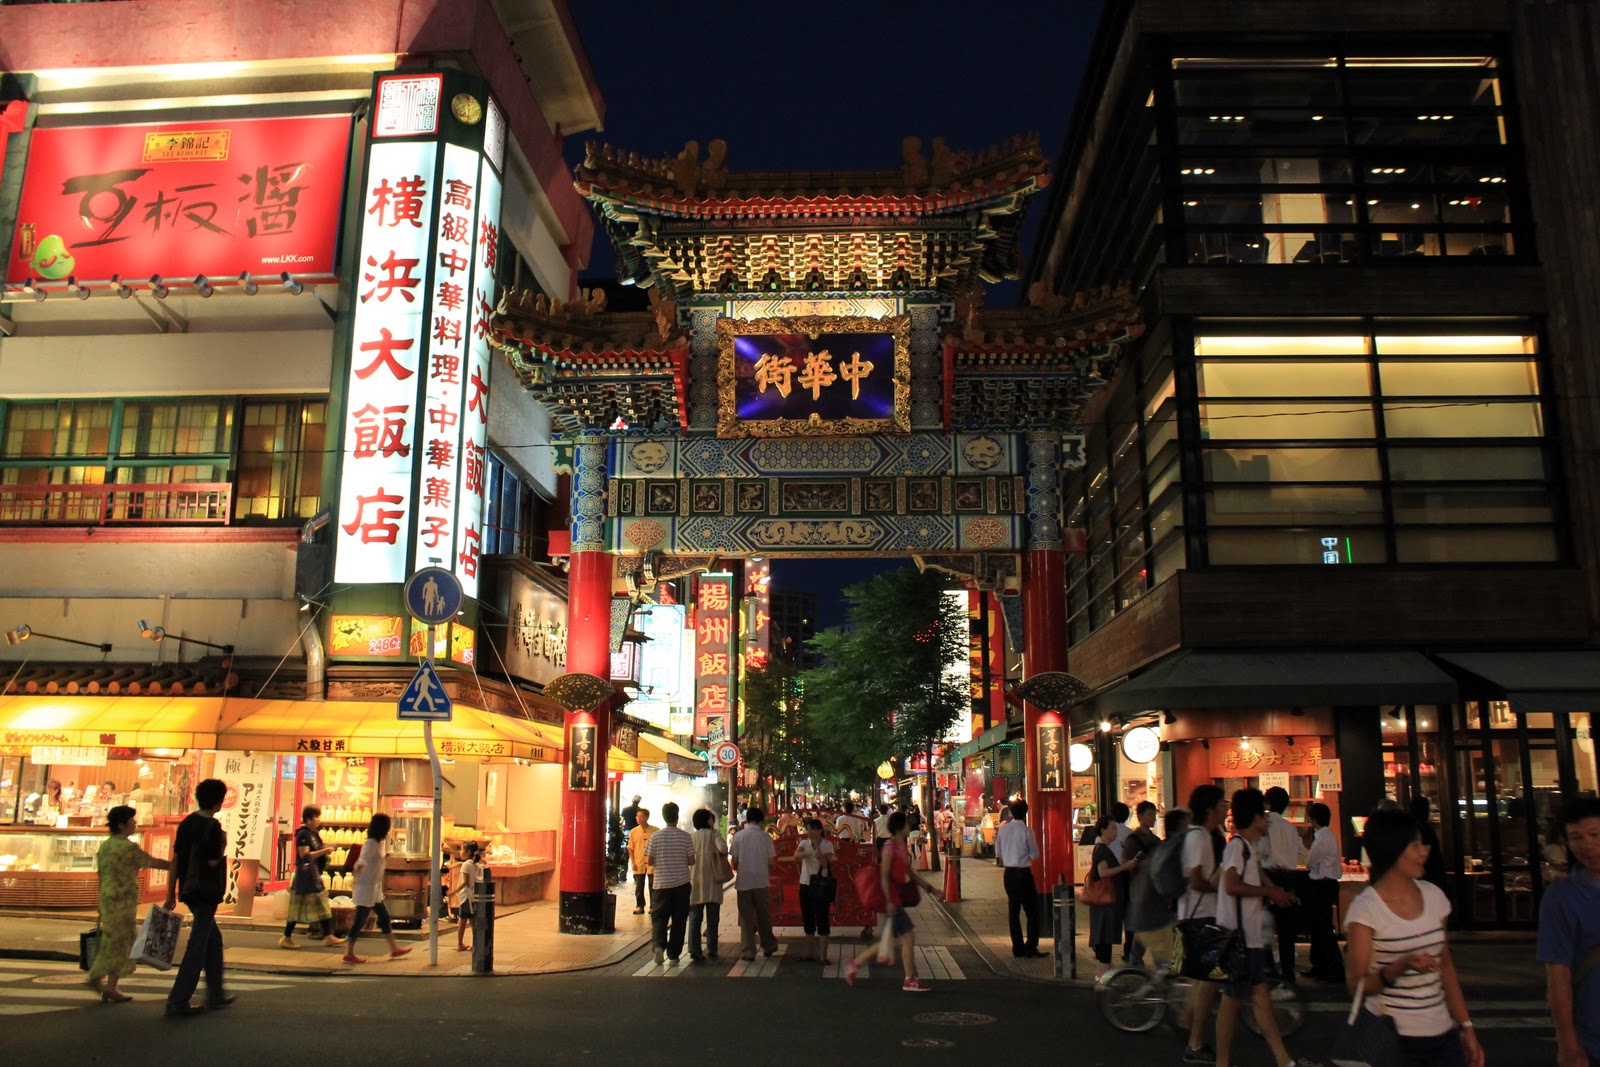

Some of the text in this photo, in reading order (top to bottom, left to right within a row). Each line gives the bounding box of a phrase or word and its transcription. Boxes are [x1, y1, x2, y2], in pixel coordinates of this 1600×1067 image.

[167, 136, 210, 151] 李錦記
[261, 253, 314, 264] www.LKK.com
[342, 174, 427, 545] 横浜大飯店
[420, 179, 473, 548] 高級中華料理・中華菓子
[753, 349, 875, 401] 中華街
[458, 213, 498, 580] 横浜大飯店
[224, 757, 260, 775] 極上
[721, 749, 735, 761] 30
[224, 783, 255, 905] アンニンソフトクリーム
